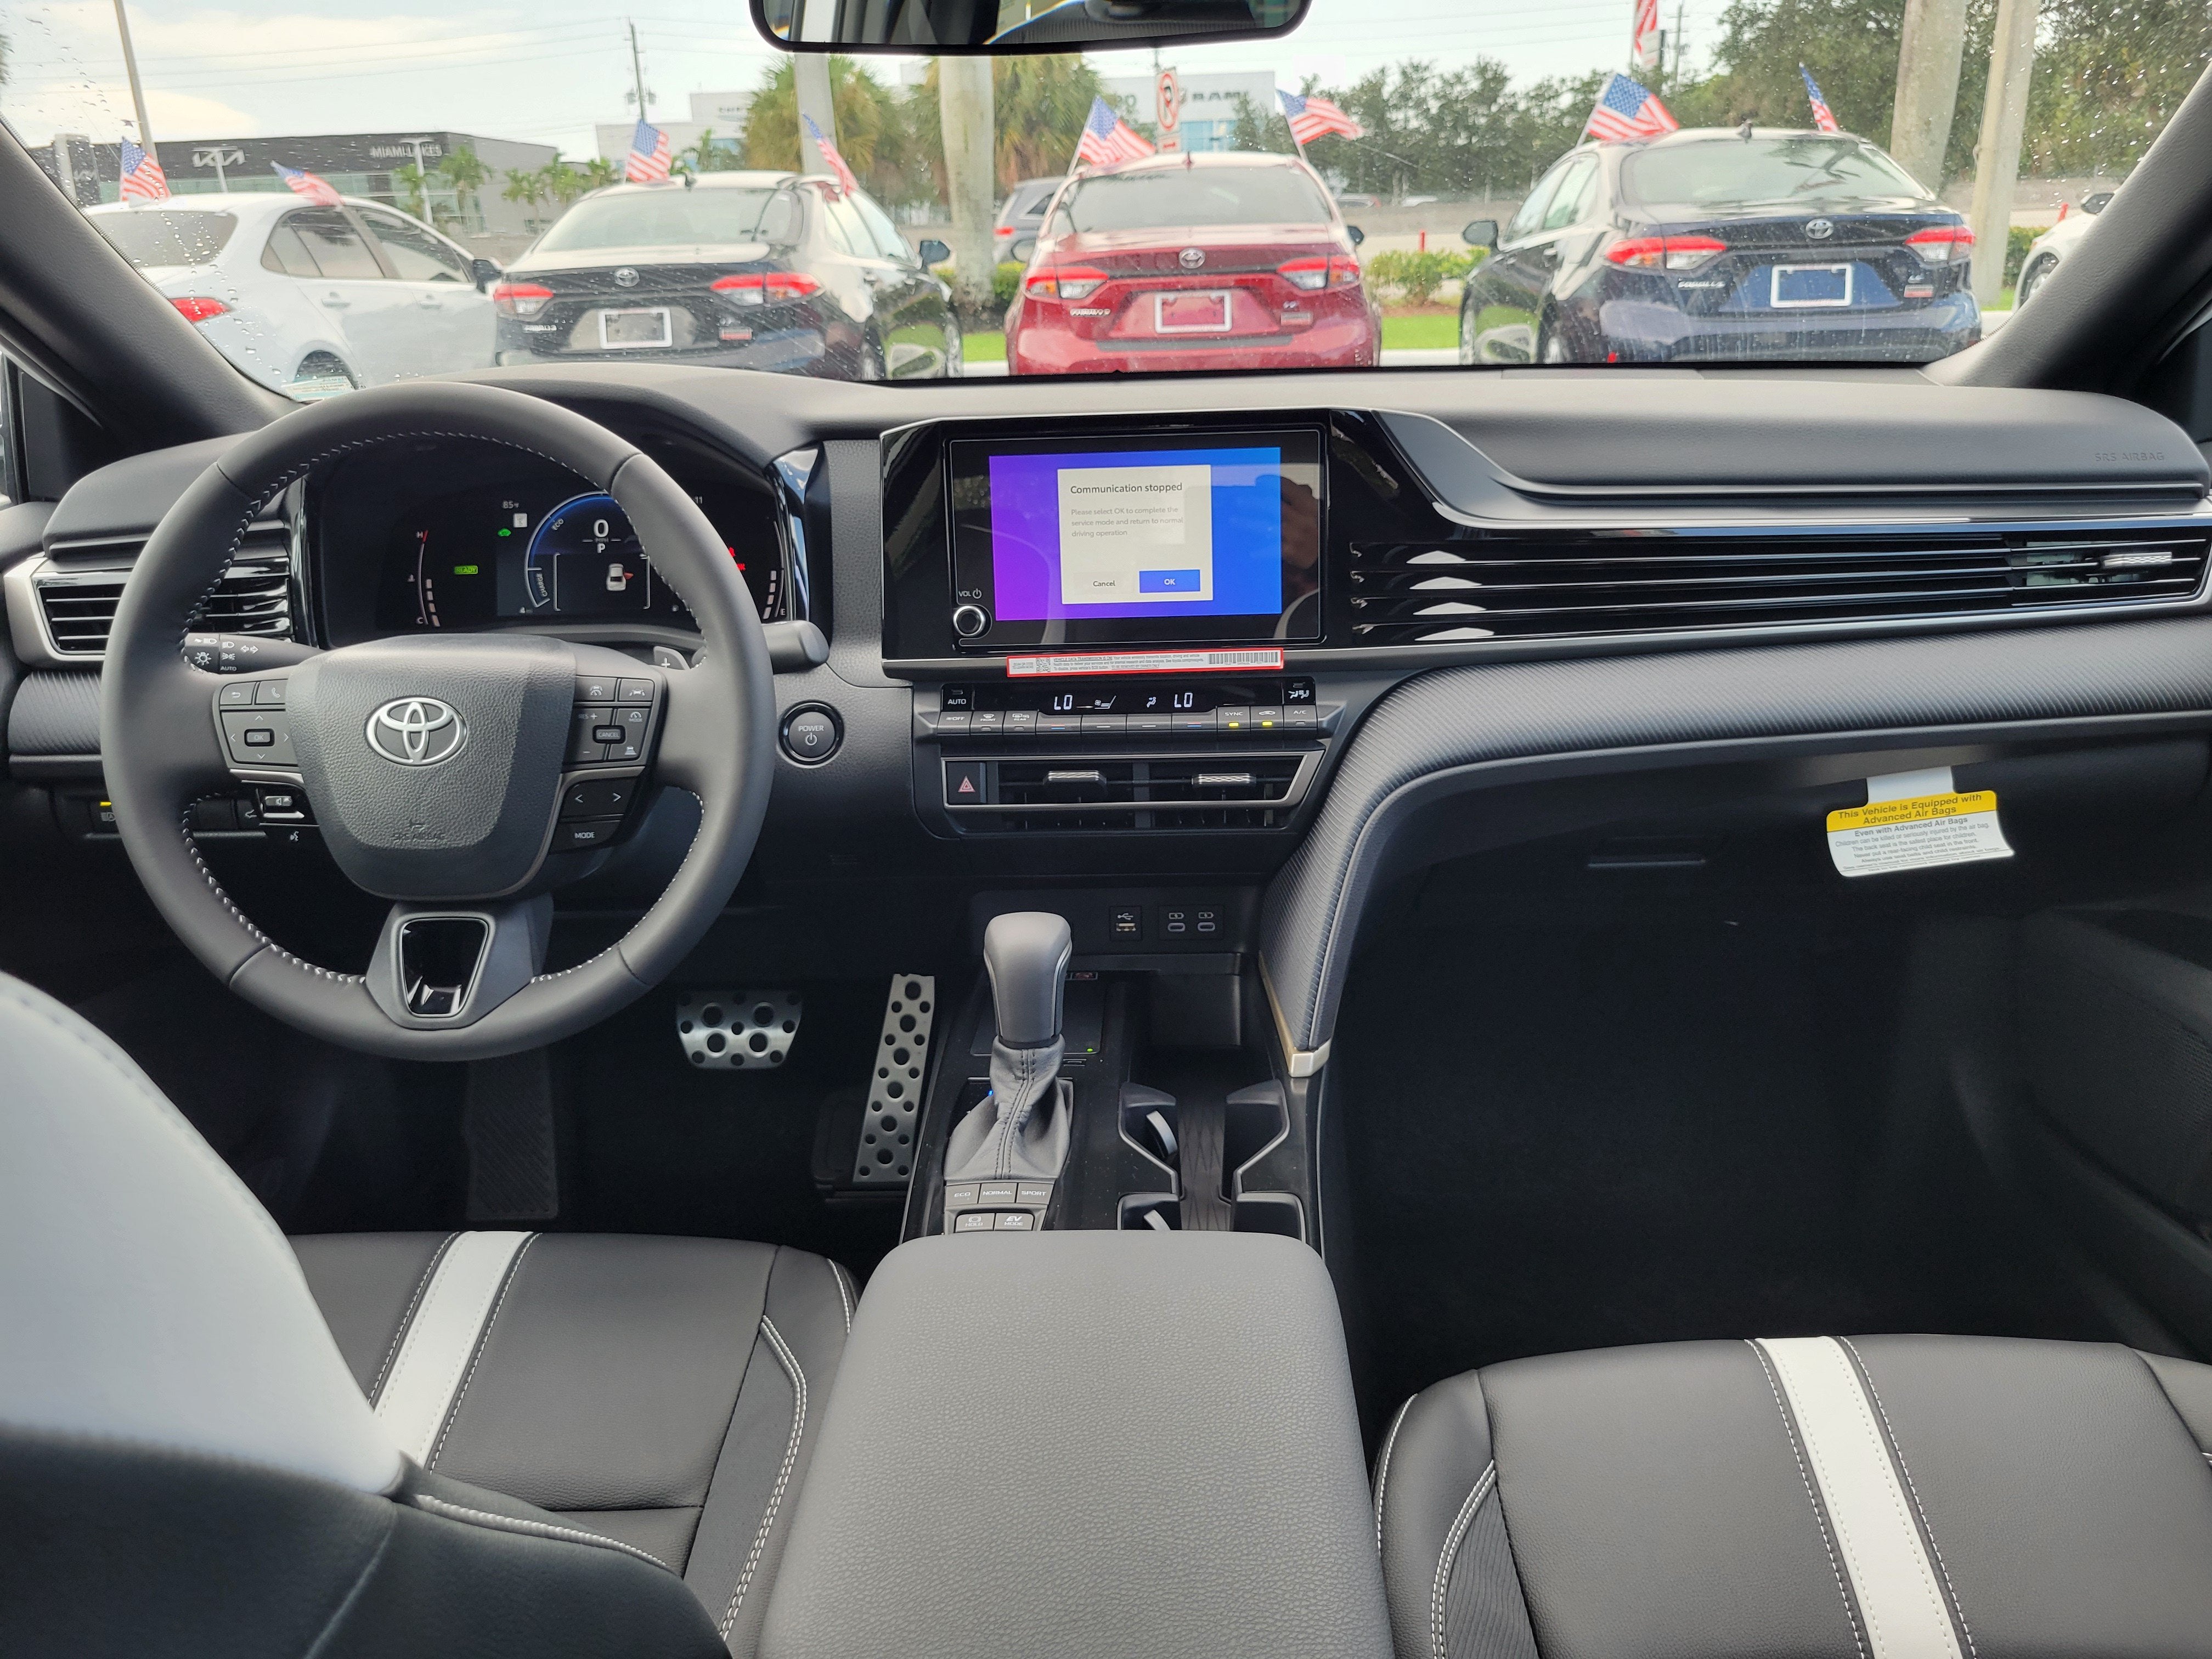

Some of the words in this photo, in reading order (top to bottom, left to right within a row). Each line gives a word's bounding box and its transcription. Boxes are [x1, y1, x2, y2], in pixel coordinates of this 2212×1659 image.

[407, 144, 443, 157] LKES
[2095, 453, 2117, 462] SRS
[2122, 452, 2164, 461] AIRBAG
[1070, 484, 1142, 494] Communication
[1145, 482, 1182, 493] stopped
[1135, 507, 1165, 515] complete
[593, 518, 609, 538] 0
[597, 543, 606, 554] P
[535, 572, 548, 597] CHARGE
[1838, 811, 1859, 820] This
[1862, 804, 1897, 816] Vehicle
[1911, 795, 1959, 811] Equipped
[1961, 793, 1982, 802] with
[1863, 812, 1912, 825] Advanced
[1915, 809, 1928, 817] Air
[1931, 805, 1957, 817] Bags
[1894, 821, 1932, 832] Advanced
